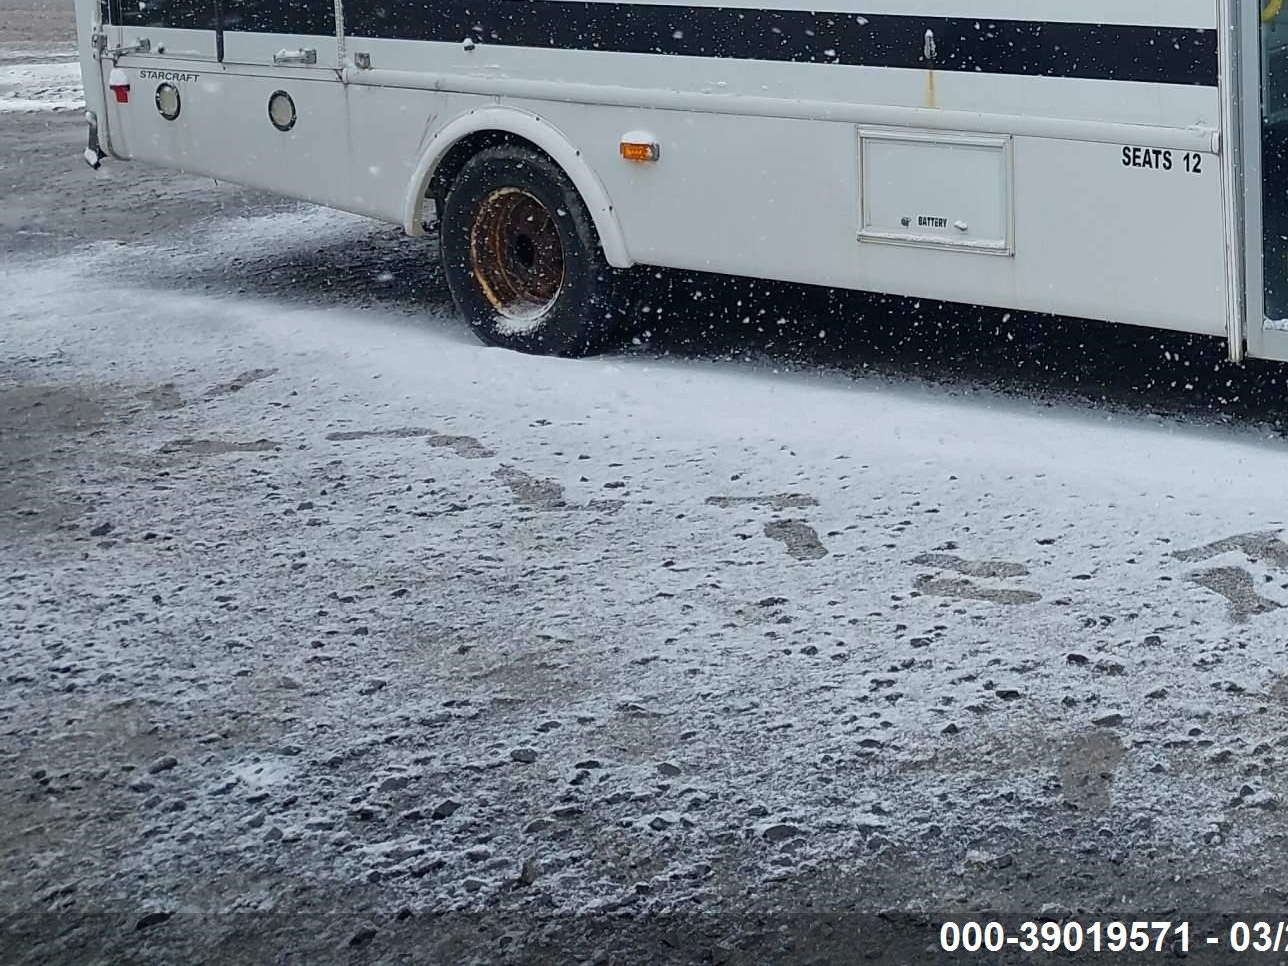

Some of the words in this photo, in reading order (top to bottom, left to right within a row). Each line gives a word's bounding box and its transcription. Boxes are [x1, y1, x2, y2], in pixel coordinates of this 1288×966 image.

[140, 70, 200, 82] STARCRAFT
[1122, 146, 1172, 171] SEATS
[1183, 152, 1202, 174] 12
[918, 216, 948, 228] BATTERY
